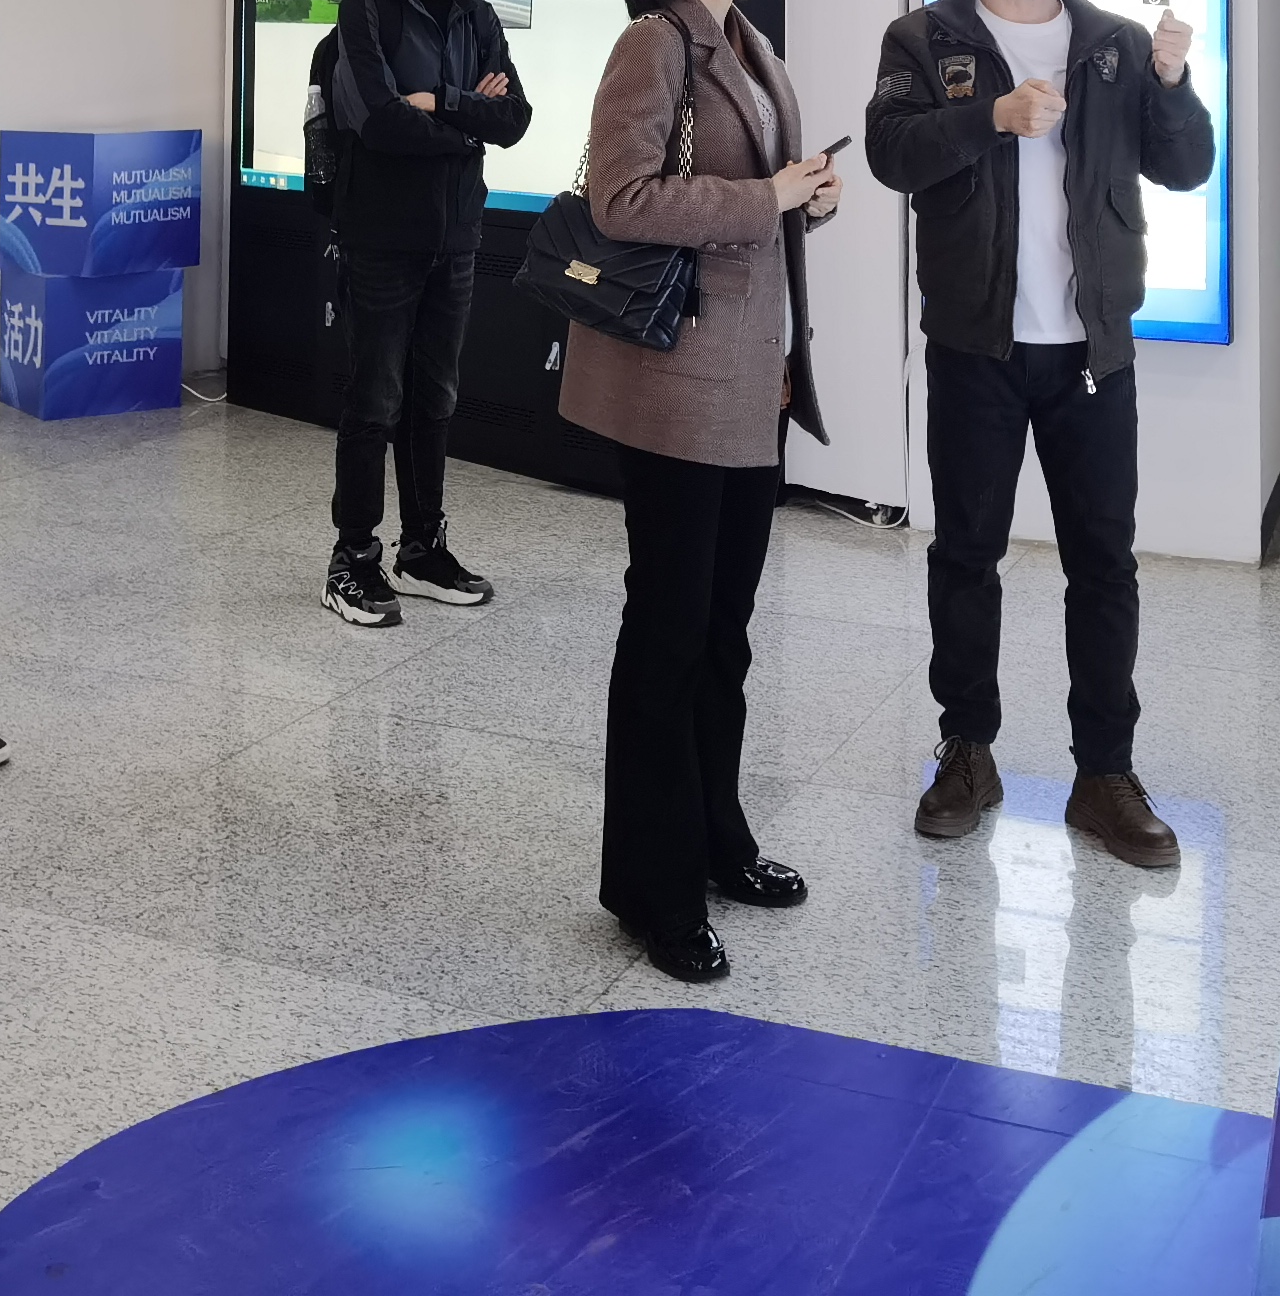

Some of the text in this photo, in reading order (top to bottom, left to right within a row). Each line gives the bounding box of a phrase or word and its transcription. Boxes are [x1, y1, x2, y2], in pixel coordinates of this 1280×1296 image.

[112, 167, 192, 185] MUTUALISM
[4, 162, 88, 228] 共生
[111, 185, 192, 204] MUTUALISM
[111, 206, 191, 225] MUTUALISM
[86, 306, 158, 324] VITALITY
[3, 299, 43, 368] 活力
[85, 326, 157, 345] VITALITY
[84, 347, 158, 365] VITALITY
